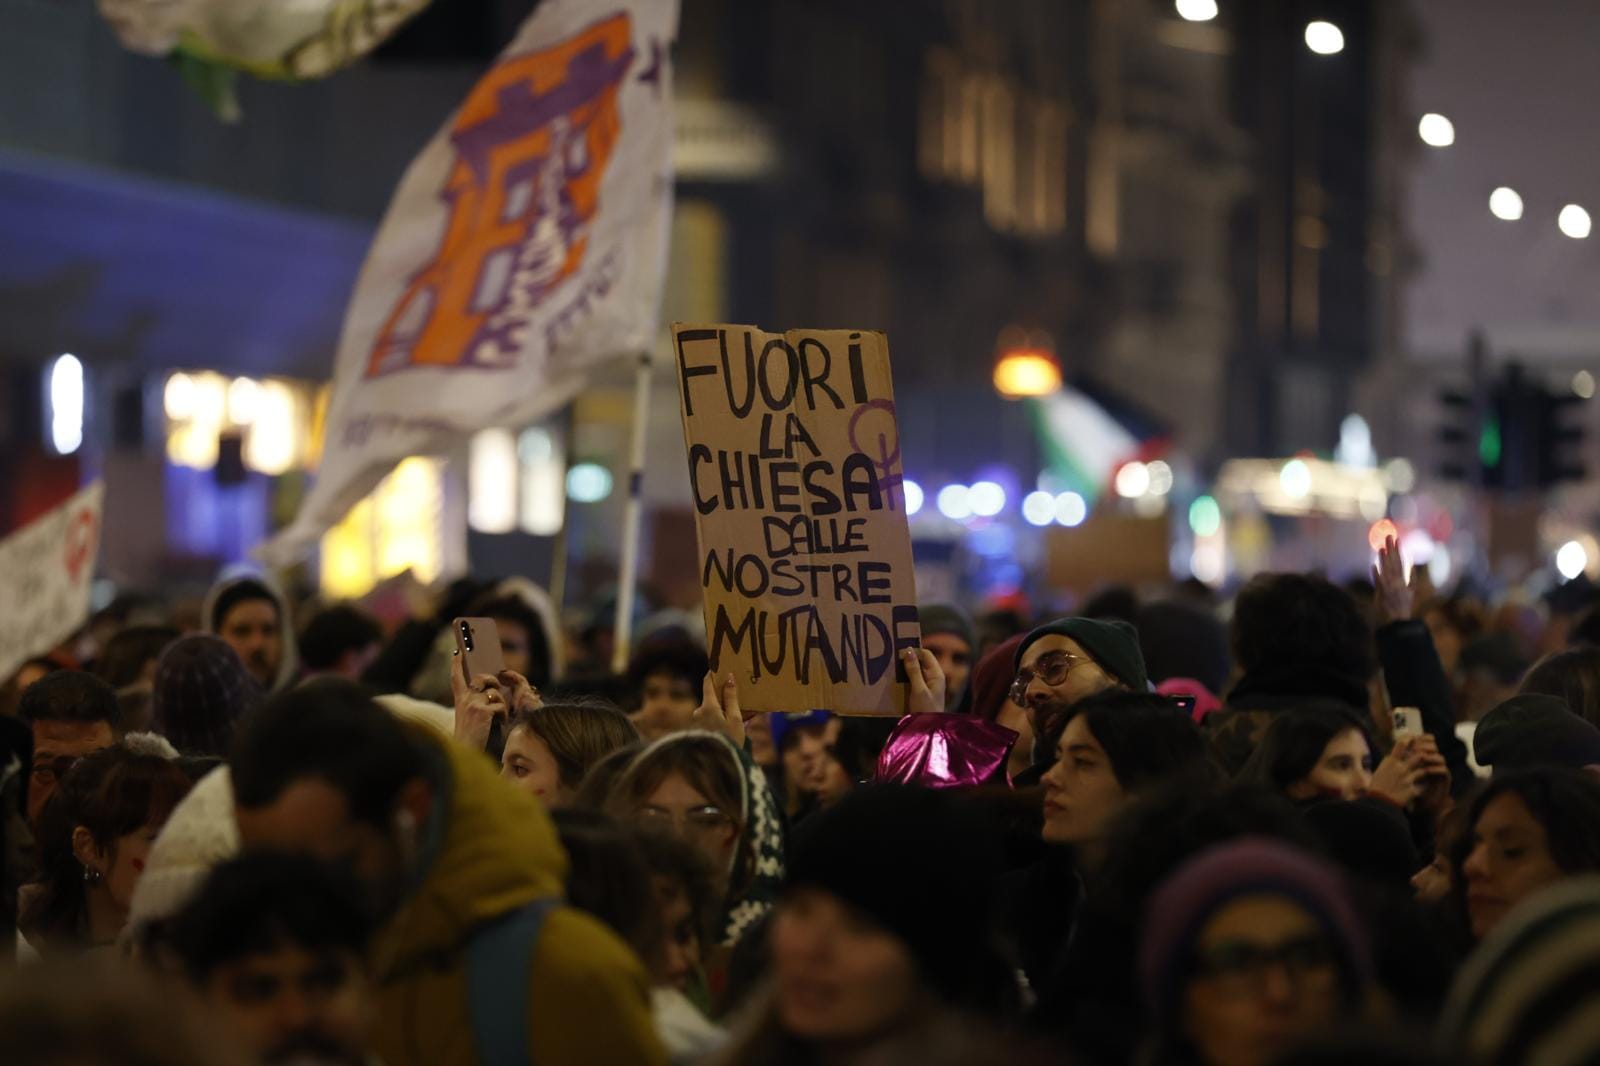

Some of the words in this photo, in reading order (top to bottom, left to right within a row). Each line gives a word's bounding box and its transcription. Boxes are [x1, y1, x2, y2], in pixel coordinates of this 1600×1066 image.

[759, 413, 822, 459] LA
[689, 444, 882, 514] CHIESA
[763, 516, 869, 558] DALLE
[703, 549, 891, 604] NOSTRE
